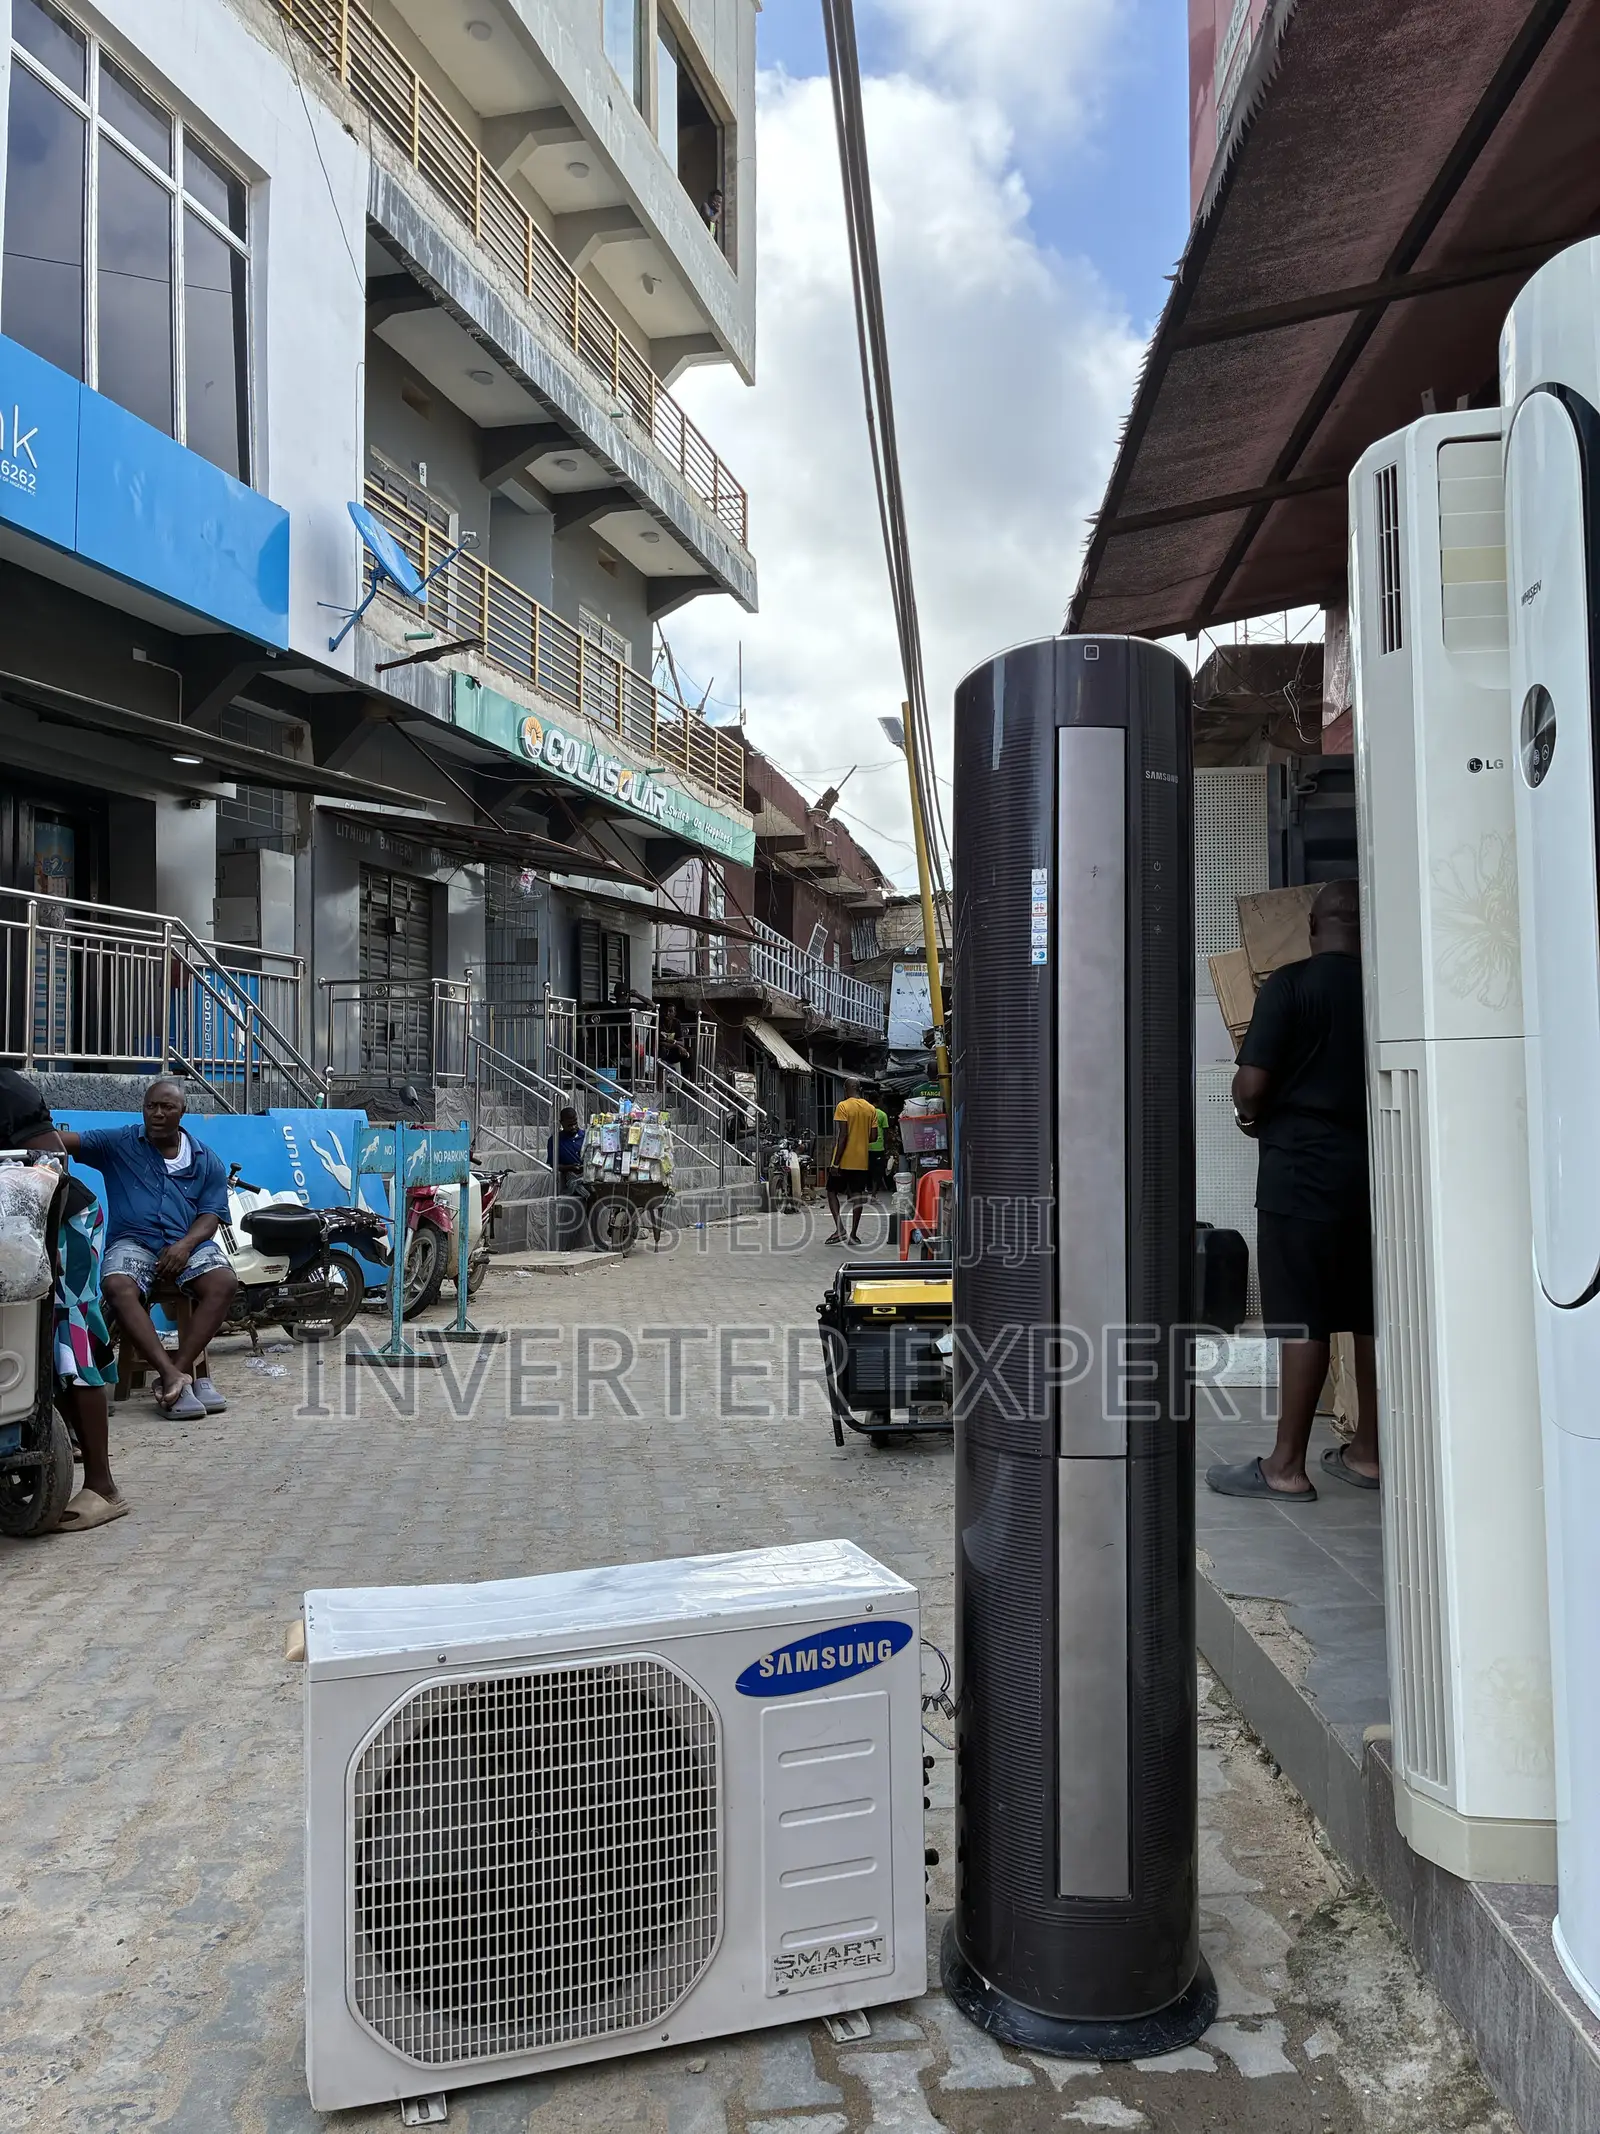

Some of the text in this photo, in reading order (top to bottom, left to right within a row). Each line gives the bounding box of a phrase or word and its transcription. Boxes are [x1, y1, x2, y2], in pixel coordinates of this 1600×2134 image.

[1485, 758, 1504, 770] LG
[1145, 770, 1179, 784] SAMSUNG
[336, 822, 371, 844] LITHIUM
[379, 836, 413, 860] BATTERY
[384, 1145, 393, 1155] NO
[433, 1150, 468, 1163] NO PARKING
[759, 1639, 892, 1678] SAMSUNG
[773, 1937, 883, 1970] SMART
